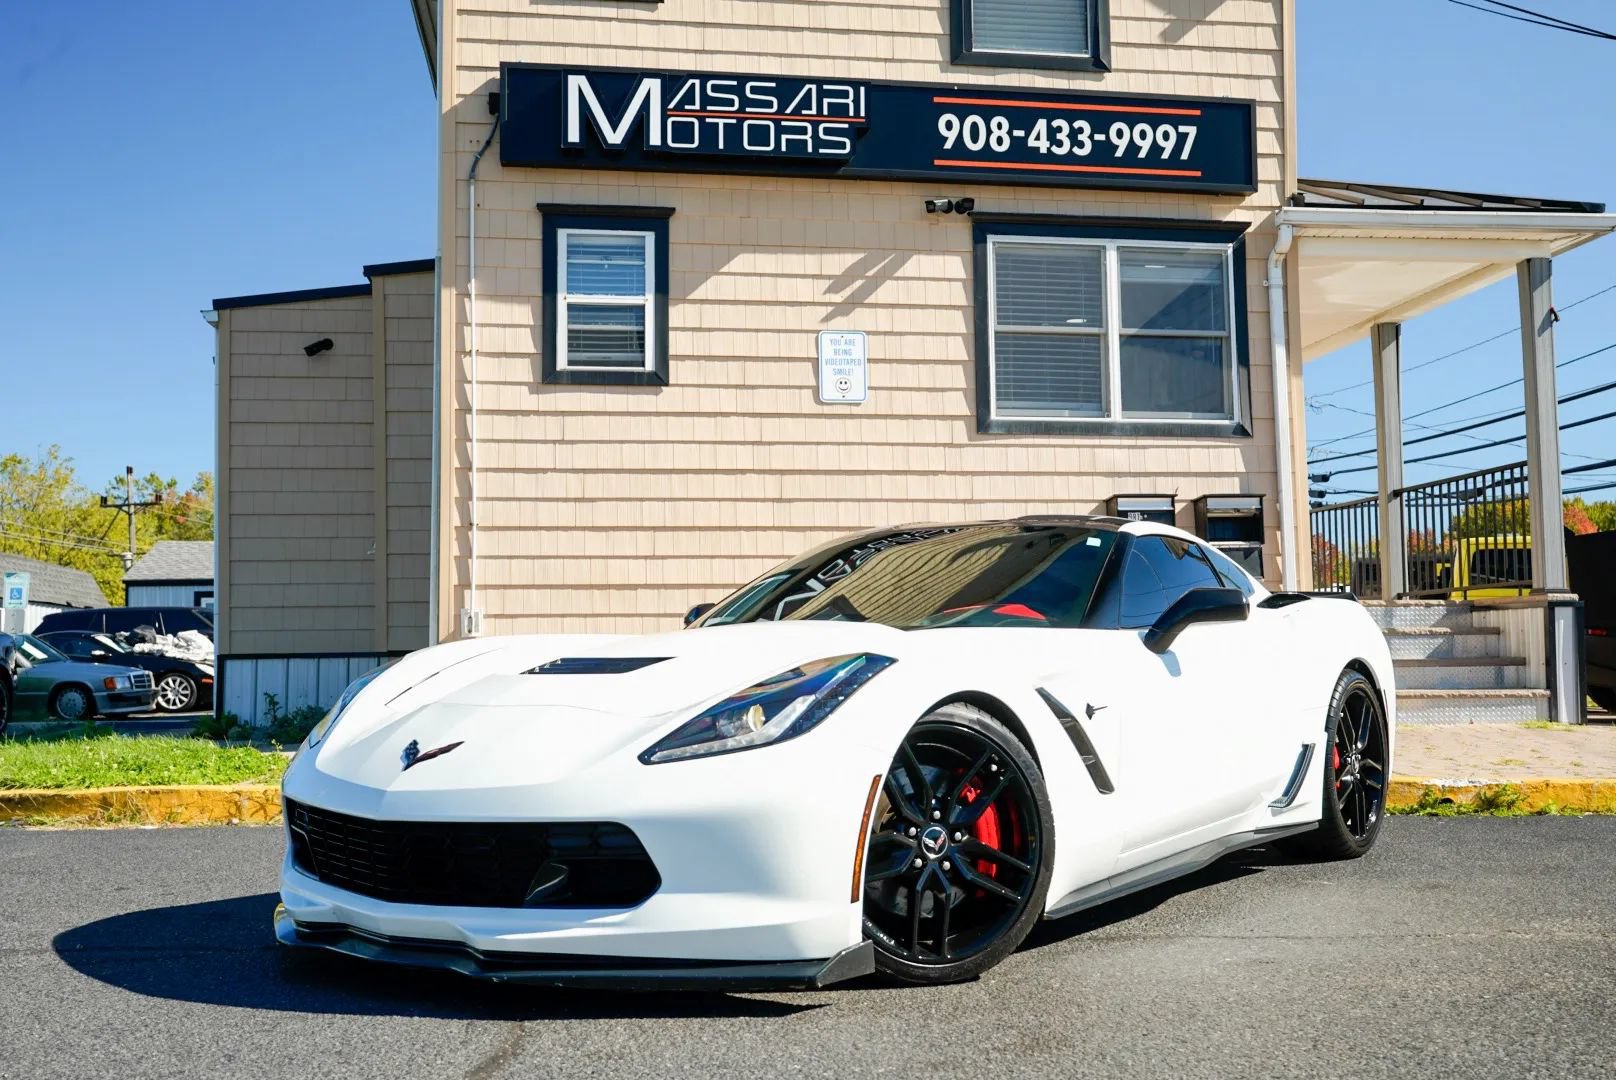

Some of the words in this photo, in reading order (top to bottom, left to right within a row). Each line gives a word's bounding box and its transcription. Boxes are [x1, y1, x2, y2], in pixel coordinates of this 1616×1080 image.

[937, 113, 1198, 160] 908-433-9997
[830, 338, 842, 346] YOU
[844, 338, 856, 346] ARE
[833, 348, 853, 356] BEING
[824, 358, 862, 366] VIDEOTAPED
[832, 368, 854, 376] SMILE!
